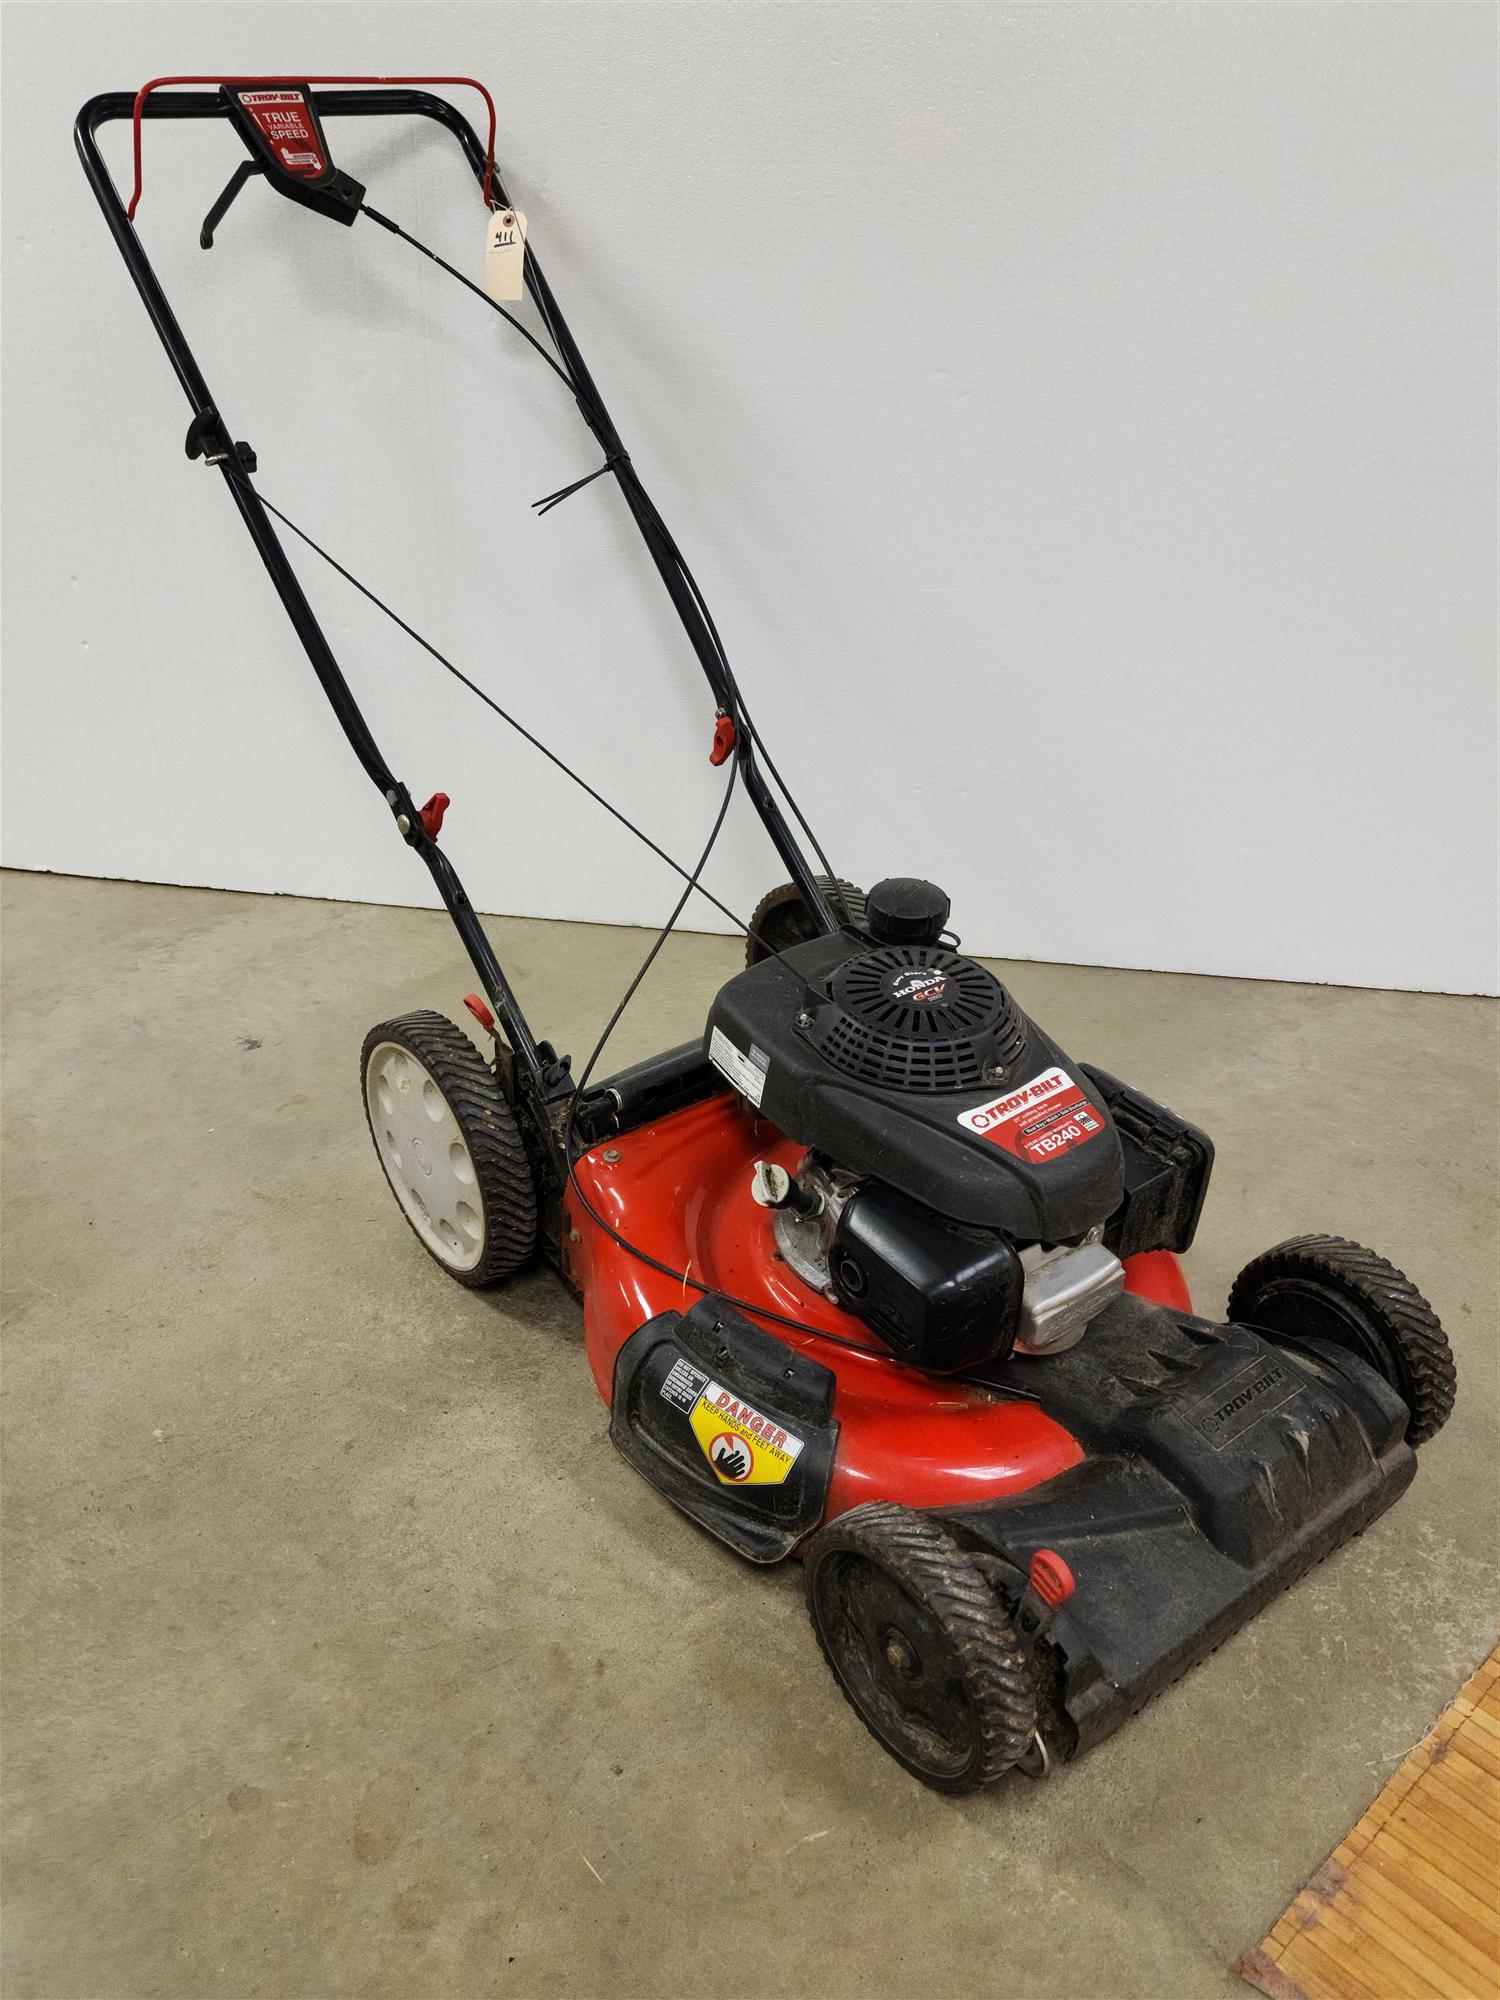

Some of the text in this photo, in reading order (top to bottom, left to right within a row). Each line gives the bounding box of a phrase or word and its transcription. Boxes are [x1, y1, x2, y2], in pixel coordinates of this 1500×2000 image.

[251, 93, 300, 102] TROY-BILT
[262, 111, 301, 123] TRUE
[271, 129, 309, 139] SPEED
[495, 230, 514, 243] 411
[892, 976, 947, 998] HONDA
[912, 983, 946, 1002] GCV
[985, 1075, 1064, 1120] TROY-BILT
[1030, 1125, 1081, 1156] TB240
[1214, 1367, 1284, 1422] TROY-BILT
[715, 1391, 788, 1449] DANGER
[702, 1401, 791, 1464] KEEP HANDS and FEET AWAY
